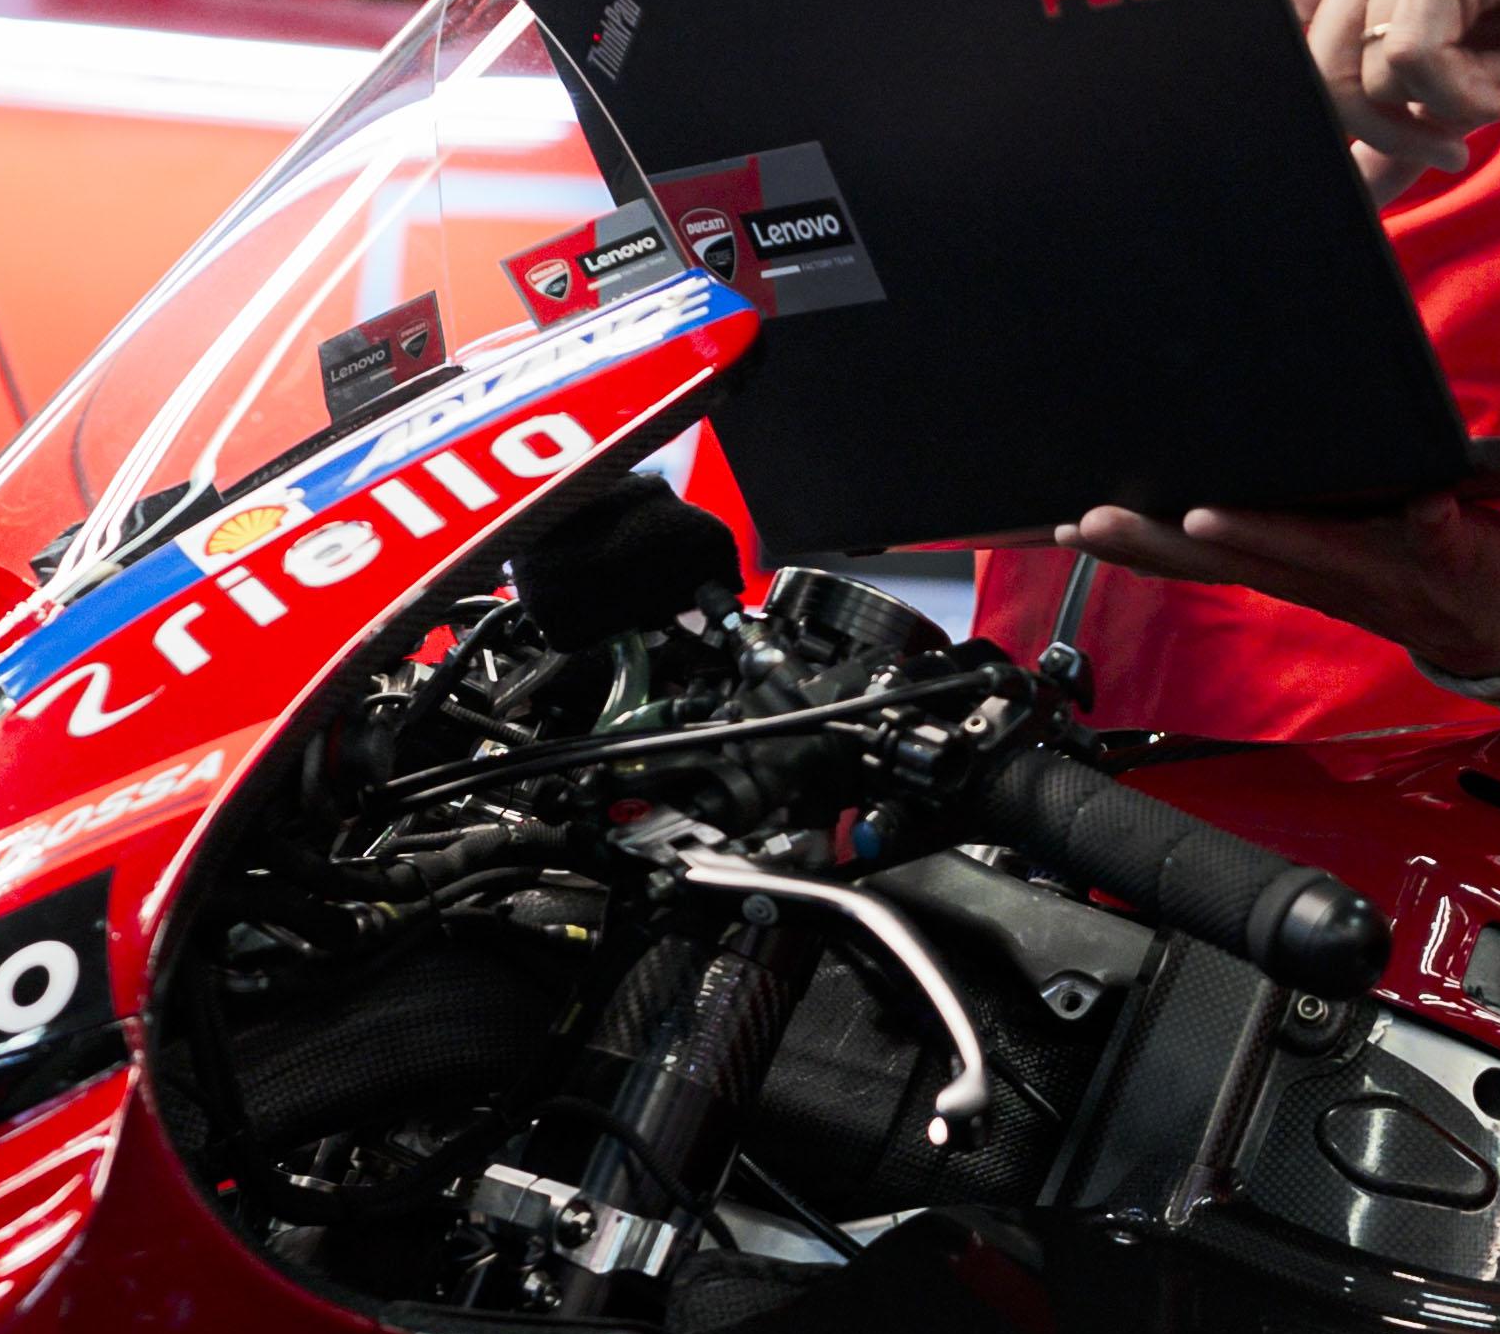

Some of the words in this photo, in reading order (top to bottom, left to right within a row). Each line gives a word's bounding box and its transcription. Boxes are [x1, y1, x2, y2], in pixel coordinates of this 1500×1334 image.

[686, 217, 726, 235] DUCATI
[750, 212, 841, 248] Lenovo
[583, 234, 658, 273] Lenovo
[330, 347, 386, 384] Lenovo
[153, 411, 597, 675] riello
